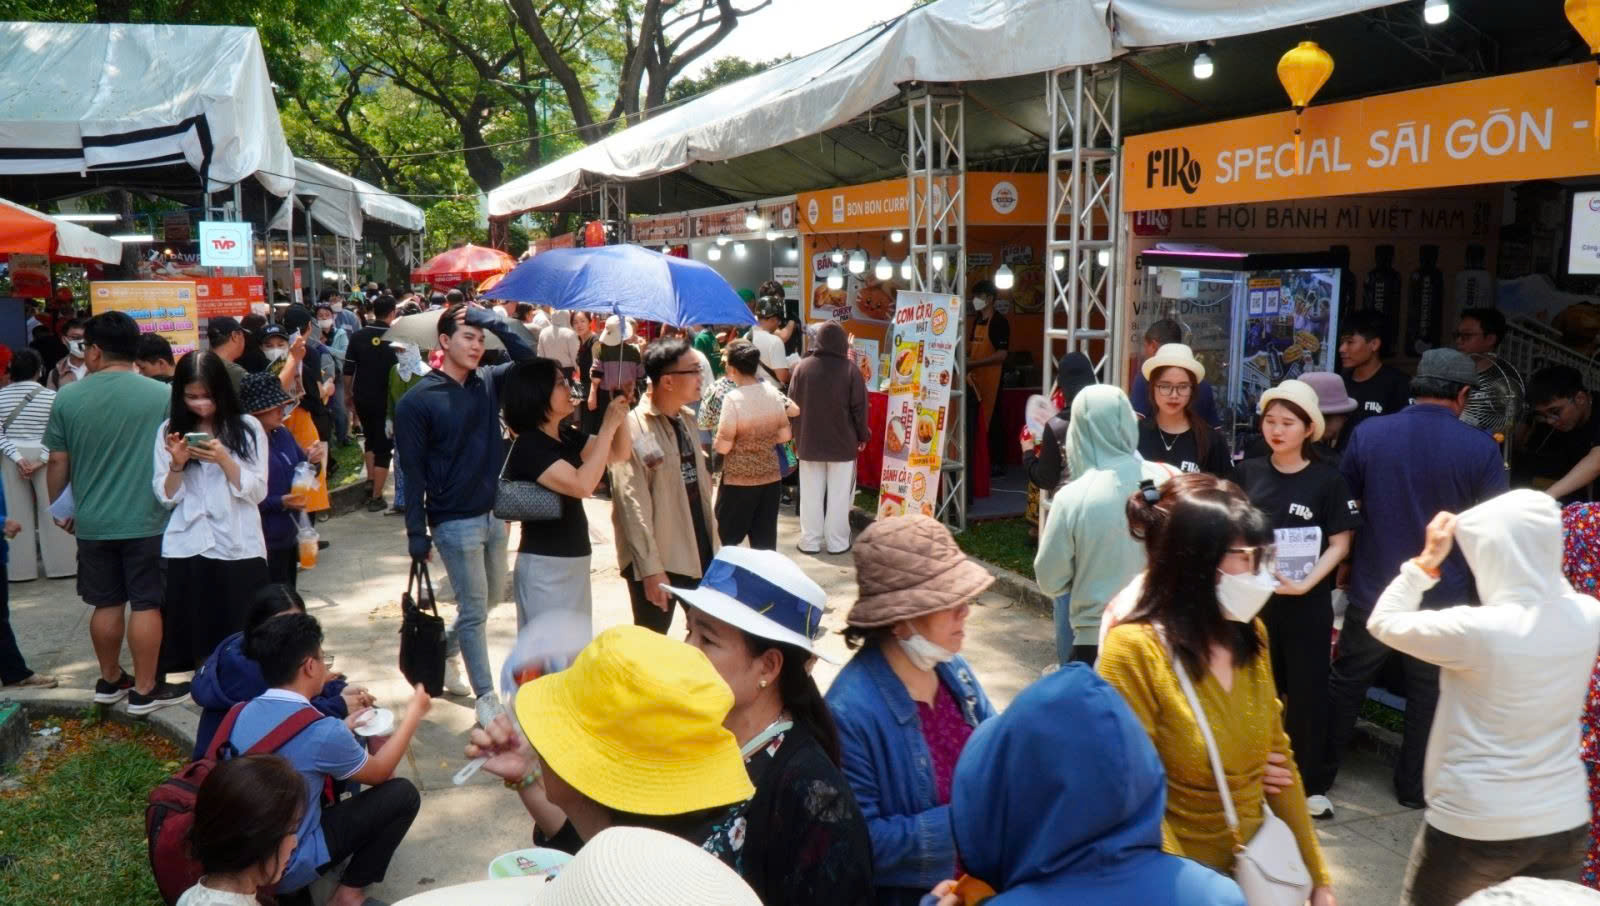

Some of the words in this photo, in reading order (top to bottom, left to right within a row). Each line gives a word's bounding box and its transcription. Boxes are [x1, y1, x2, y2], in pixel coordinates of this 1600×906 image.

[1215, 137, 1351, 184] SPECIAL
[847, 202, 864, 216] BON
[864, 199, 881, 215] BON
[883, 196, 910, 213] CURRY
[1421, 206, 1465, 229] NAM
[211, 239, 236, 250] TVP
